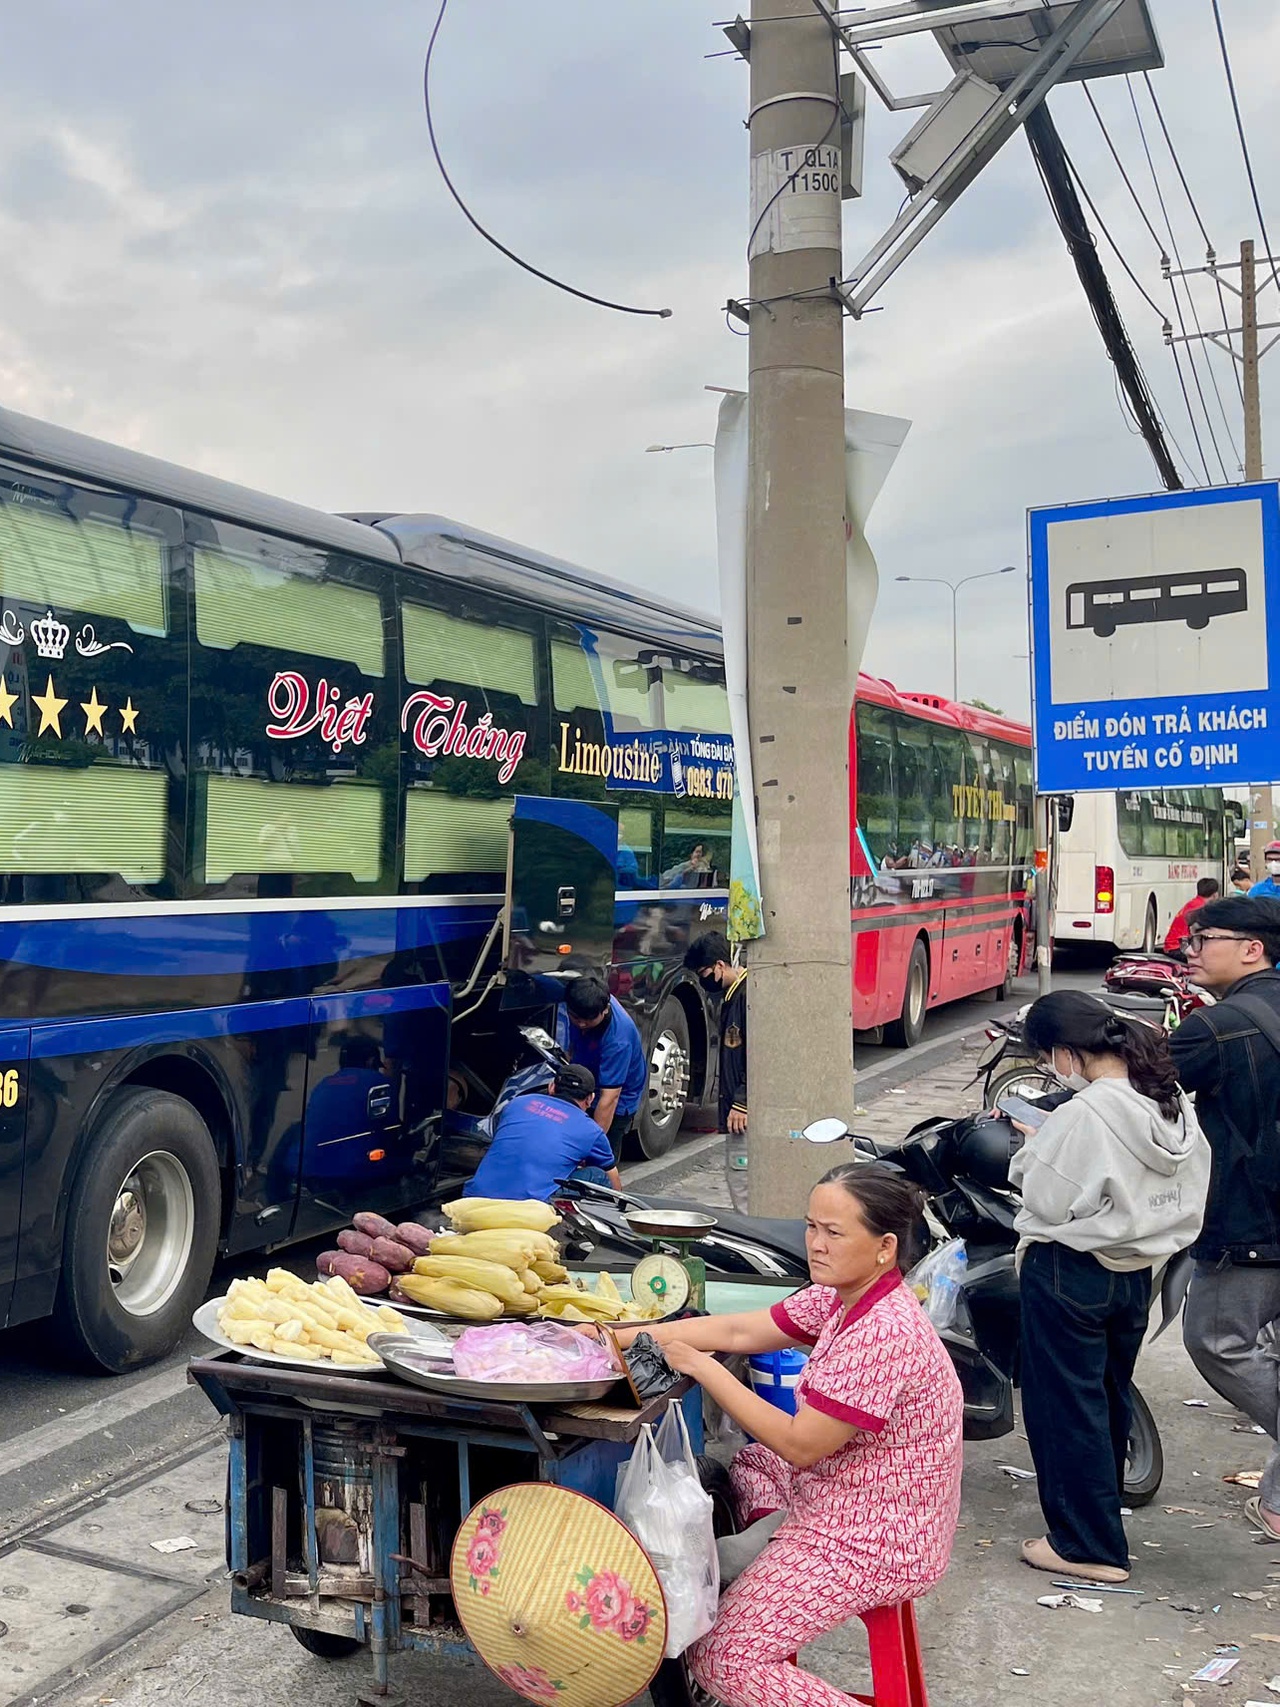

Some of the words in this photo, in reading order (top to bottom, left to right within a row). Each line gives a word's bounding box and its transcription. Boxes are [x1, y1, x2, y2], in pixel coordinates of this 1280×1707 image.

[780, 151, 793, 171] T
[266, 670, 374, 754] Việt
[401, 690, 528, 785] Thắng
[1053, 710, 1100, 741] ĐIỂM
[1105, 712, 1146, 737] ĐÓN
[1152, 705, 1192, 735] TRẢ
[1198, 705, 1268, 732] KHÁCH
[558, 722, 660, 783] Limousine
[1083, 742, 1148, 771] TUYẾN
[1154, 740, 1185, 768] CỐ
[1190, 743, 1238, 770] ĐỊNH
[687, 767, 715, 799] 0983.
[716, 770, 734, 801] 970
